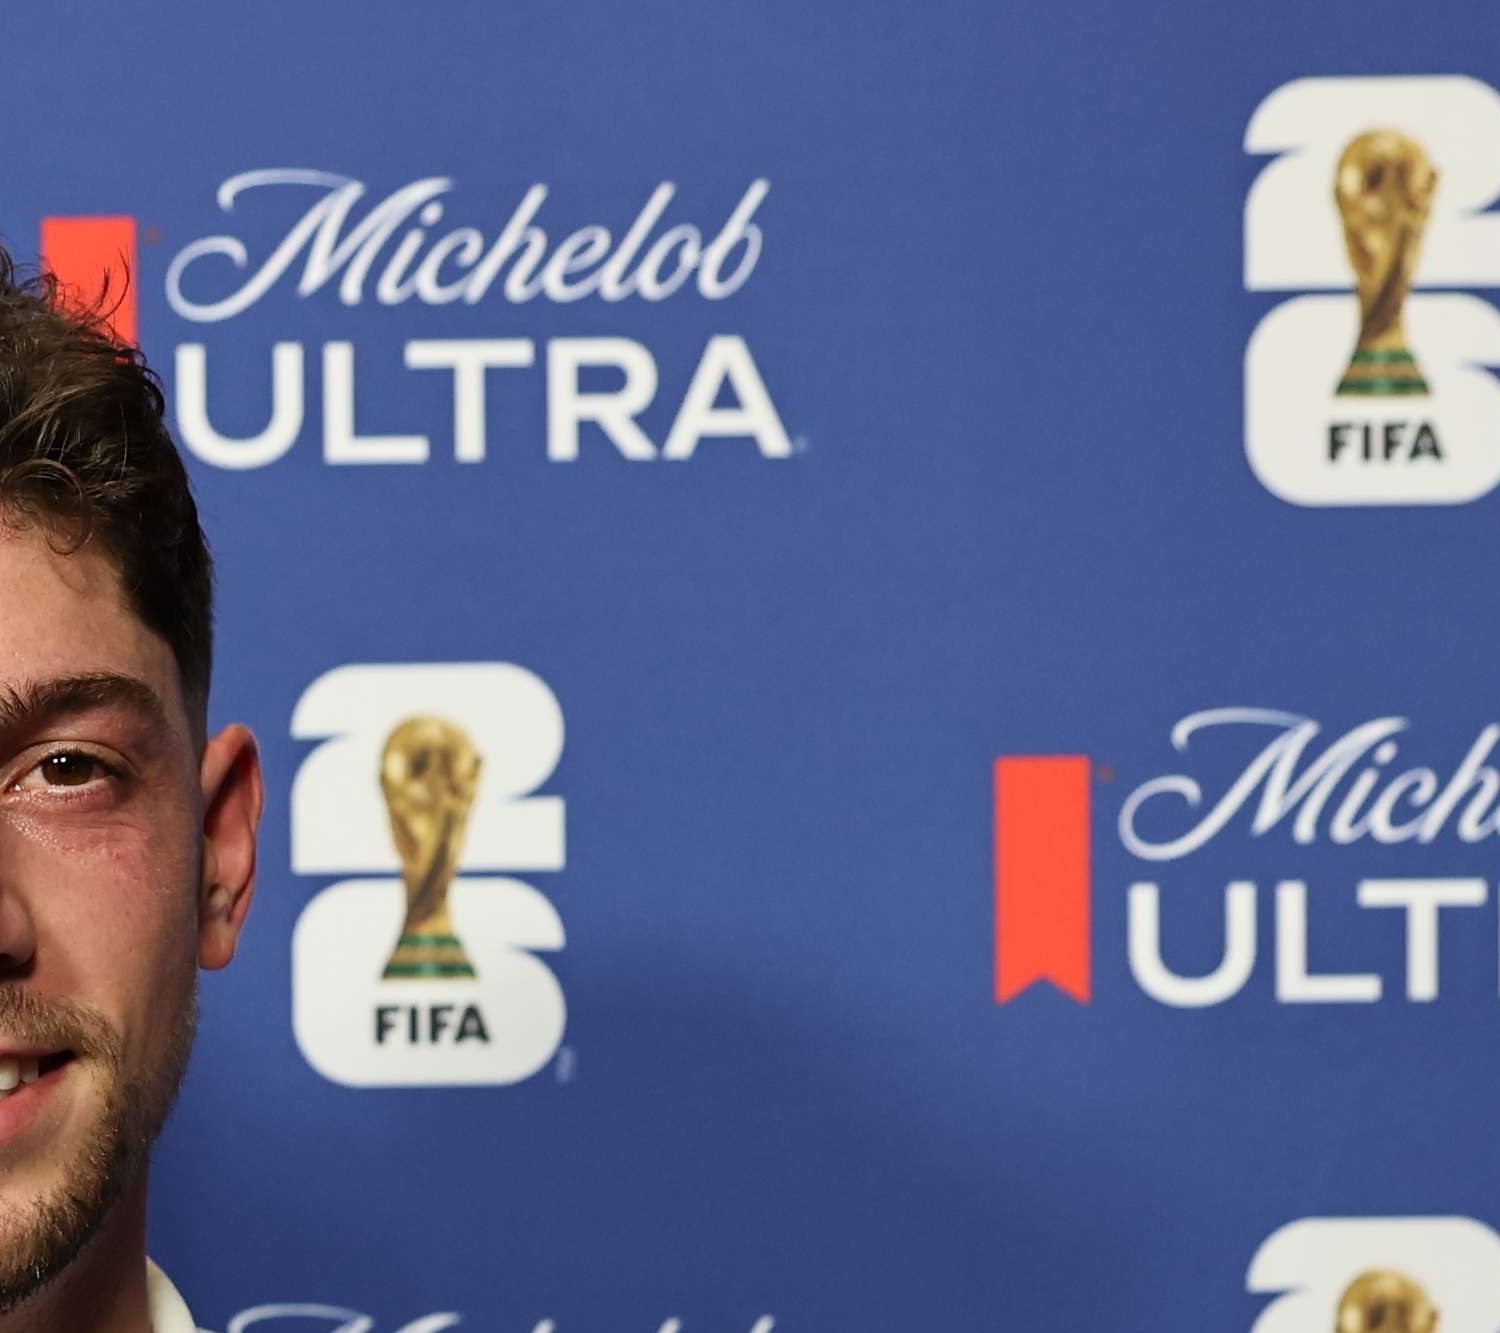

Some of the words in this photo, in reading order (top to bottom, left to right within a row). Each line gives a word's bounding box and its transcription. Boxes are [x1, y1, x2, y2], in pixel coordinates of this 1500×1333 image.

[167, 171, 767, 321] Michelob
[176, 337, 790, 468] ULTRA
[1329, 424, 1442, 461] FIFA
[376, 1005, 489, 1044] FIFA
